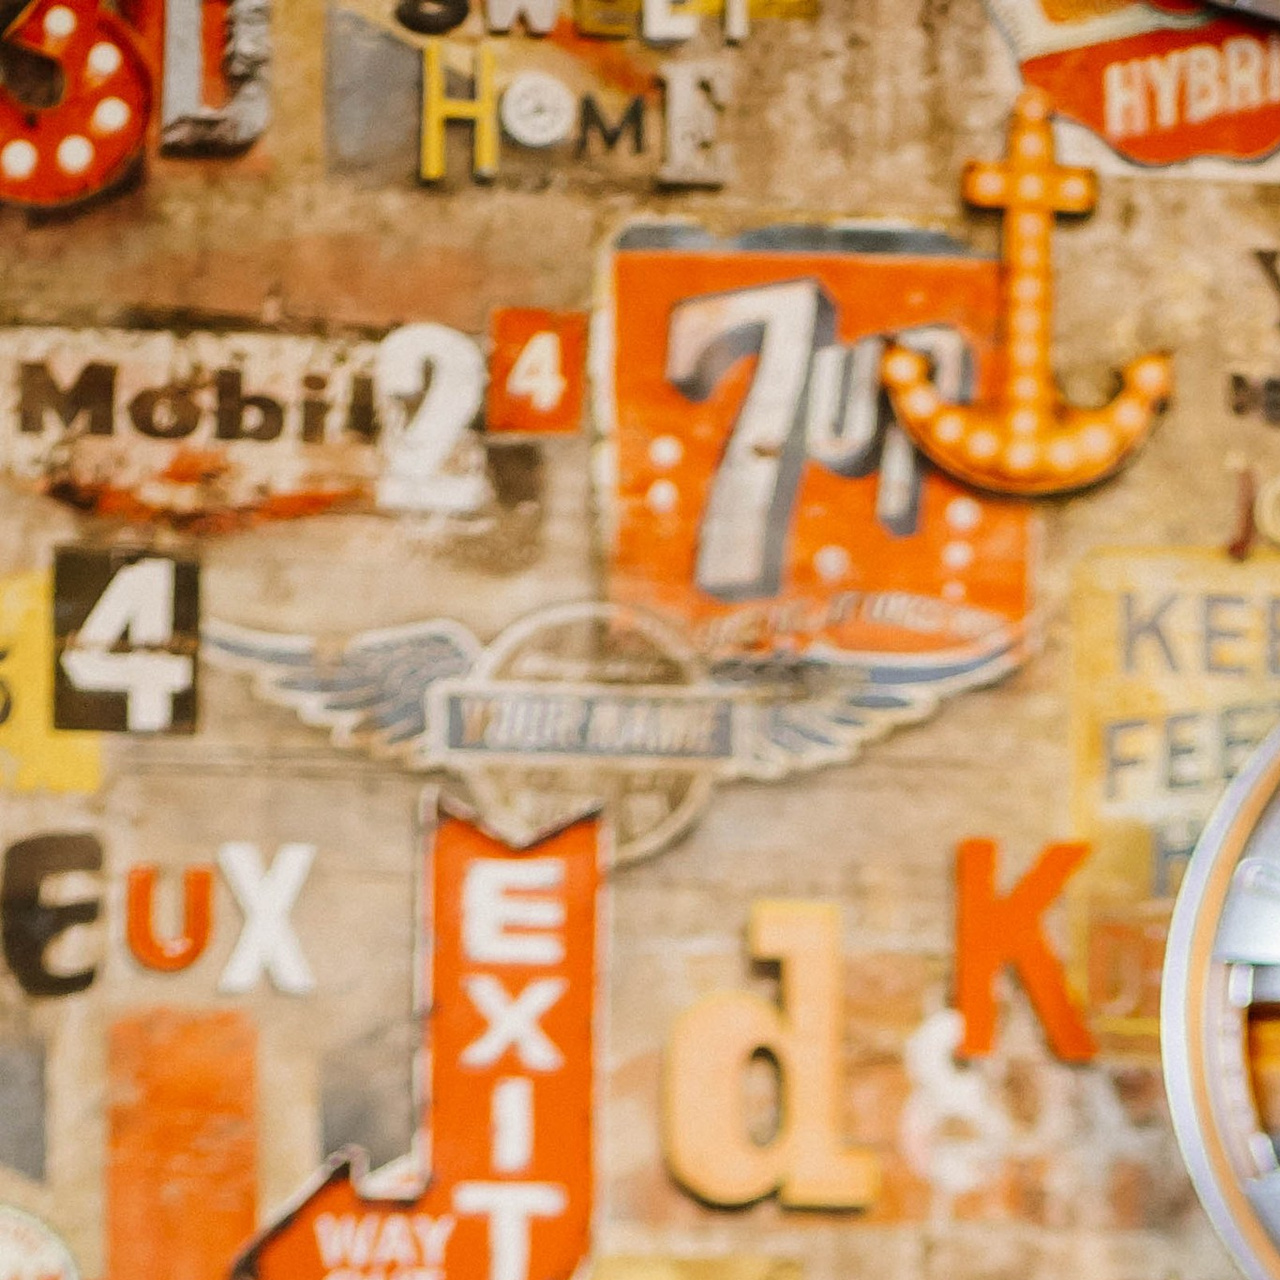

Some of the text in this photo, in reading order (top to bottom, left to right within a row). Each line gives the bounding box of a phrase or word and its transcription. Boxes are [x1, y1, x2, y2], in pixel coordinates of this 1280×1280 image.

[419, 40, 738, 185] HOME
[375, 325, 487, 510] 2
[507, 330, 567, 412] 4
[60, 557, 193, 732] 4
[955, 838, 1097, 1062] K
[314, 1212, 453, 1270] WAY
